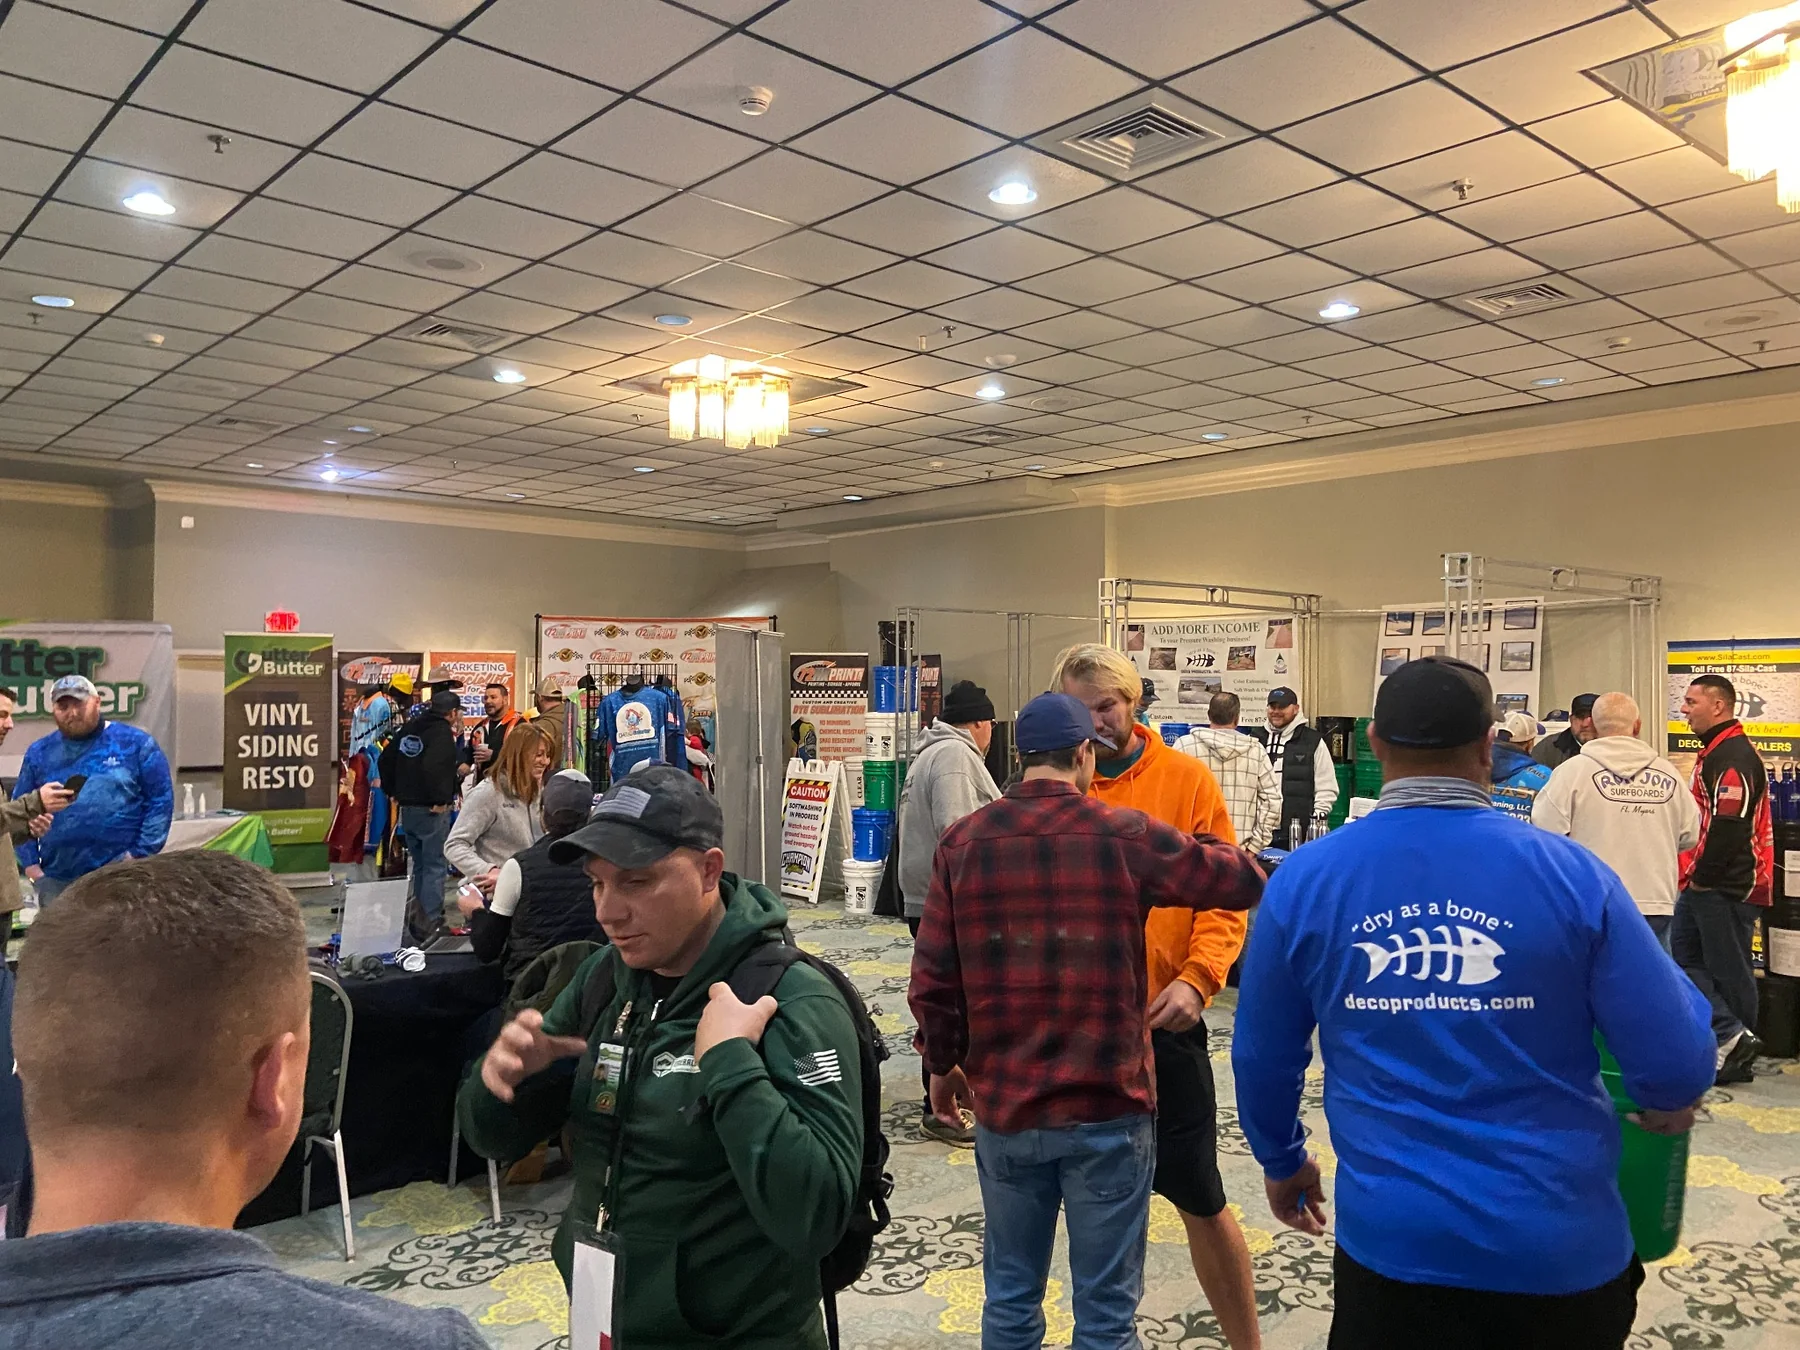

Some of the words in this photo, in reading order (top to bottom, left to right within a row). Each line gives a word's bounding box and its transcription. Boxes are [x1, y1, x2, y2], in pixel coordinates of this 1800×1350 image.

[1151, 624, 1174, 635] ADD
[1176, 624, 1209, 634] MORE
[1213, 621, 1260, 633] INCOME
[1167, 637, 1178, 645] your
[1202, 636, 1226, 644] Washing
[0, 642, 99, 676] tter
[1697, 653, 1770, 661] www.SilaCast.com
[264, 661, 323, 675] Butter
[442, 663, 505, 672] MARKETING
[1691, 665, 1705, 673] Toll
[1707, 665, 1724, 673] Free
[1726, 664, 1776, 673] 87-Sila-Cast
[244, 703, 313, 726] VINYL
[810, 705, 866, 715] SUBLIMATION
[238, 734, 318, 758] SIDING
[243, 765, 314, 790] RESTO
[1640, 772, 1672, 790] JON
[790, 786, 827, 799] CAUTION
[1610, 788, 1665, 798] SURFBOARDS
[788, 802, 823, 812] SOFTWASHING
[1516, 804, 1531, 812] LLC
[1632, 805, 1656, 817] Myers
[795, 812, 819, 821] PROGRESS
[781, 853, 812, 872] CHAMPION
[1400, 901, 1421, 918] as
[1428, 902, 1440, 915] a
[1344, 993, 1535, 1014] decoproducts.com
